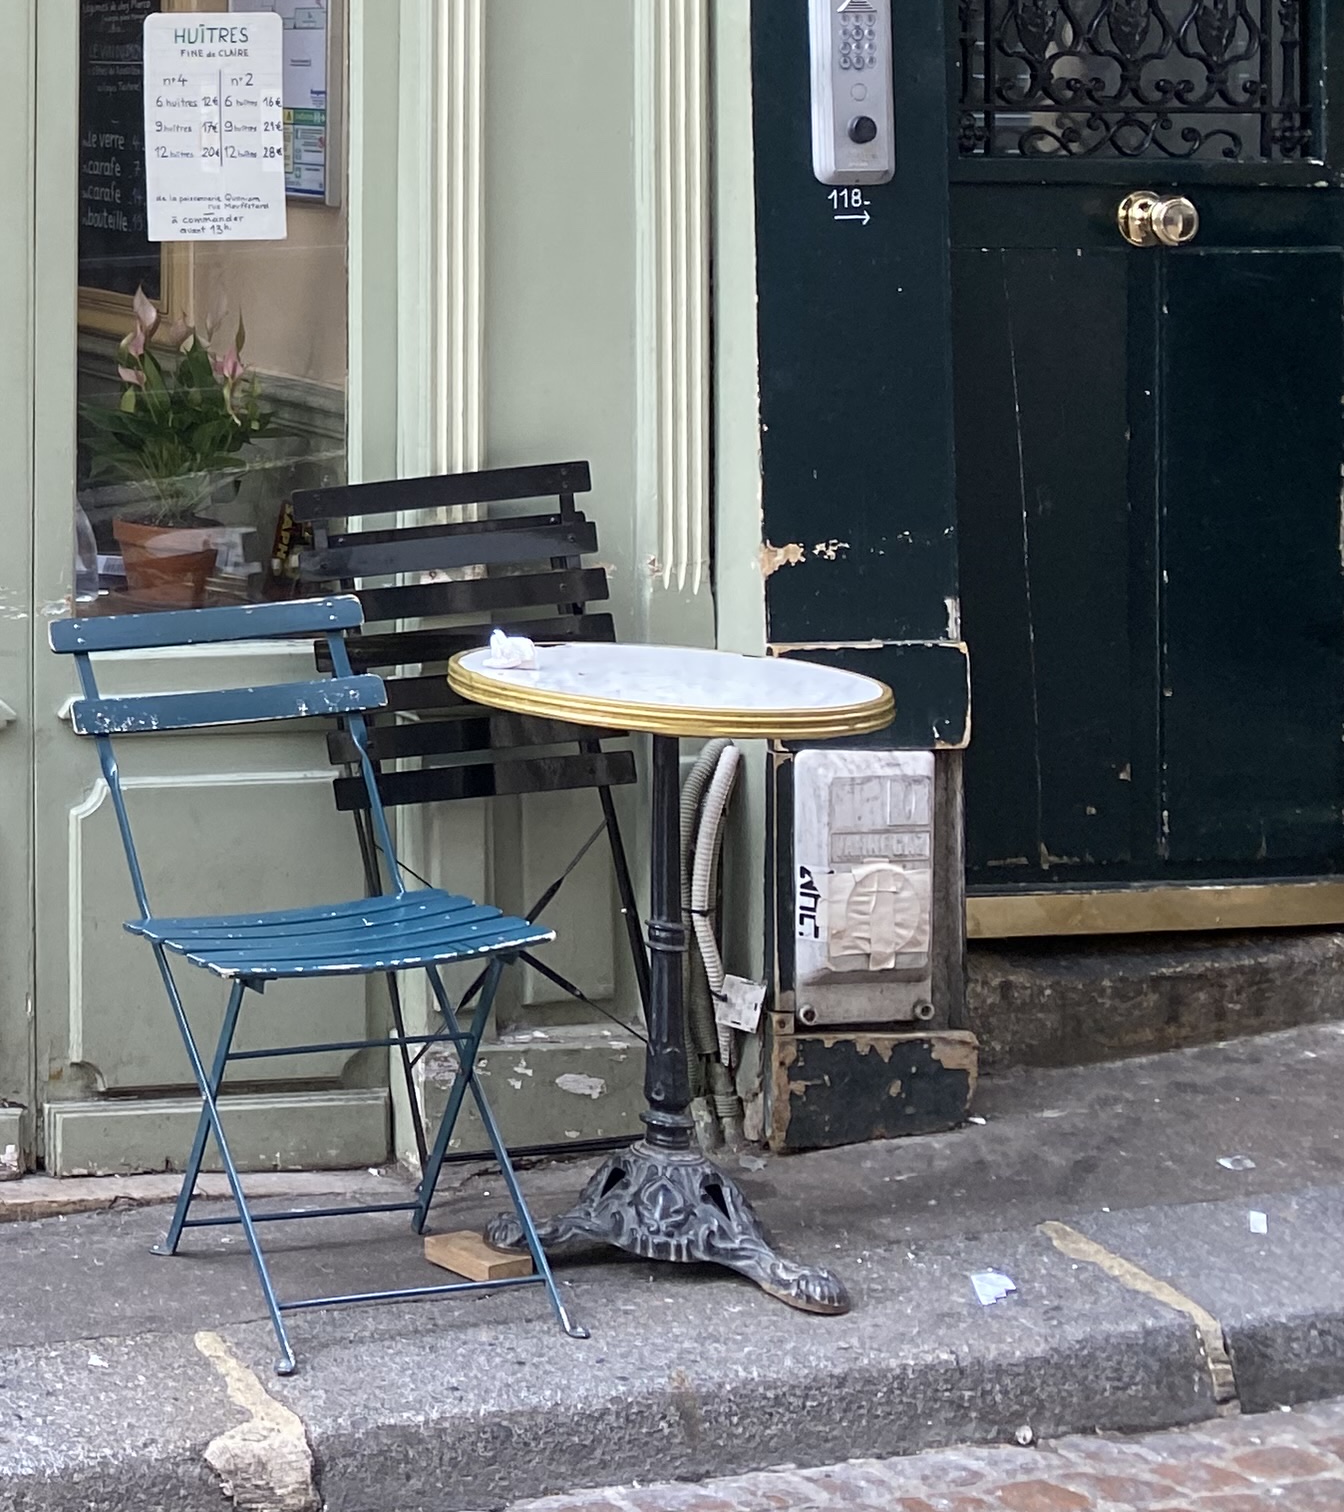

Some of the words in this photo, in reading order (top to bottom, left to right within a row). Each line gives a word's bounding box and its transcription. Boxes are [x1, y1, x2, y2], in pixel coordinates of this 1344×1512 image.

[180, 49, 204, 57] FINE
[206, 49, 216, 58] de
[218, 48, 249, 57] CLAIRE
[155, 95, 163, 107] 6
[201, 96, 219, 107] 12€
[224, 95, 233, 107] 6
[262, 96, 282, 108] 16€
[155, 120, 163, 132] 9
[223, 120, 234, 133] 9
[263, 121, 282, 132] 21€
[98, 132, 125, 150] verre
[155, 146, 169, 158] 12
[201, 146, 220, 158] 20€
[224, 145, 238, 158] 12
[262, 146, 282, 158] 28€
[87, 156, 121, 177] carafe
[87, 181, 121, 204] carafe
[87, 206, 129, 232] bouteille
[182, 214, 244, 224] commander
